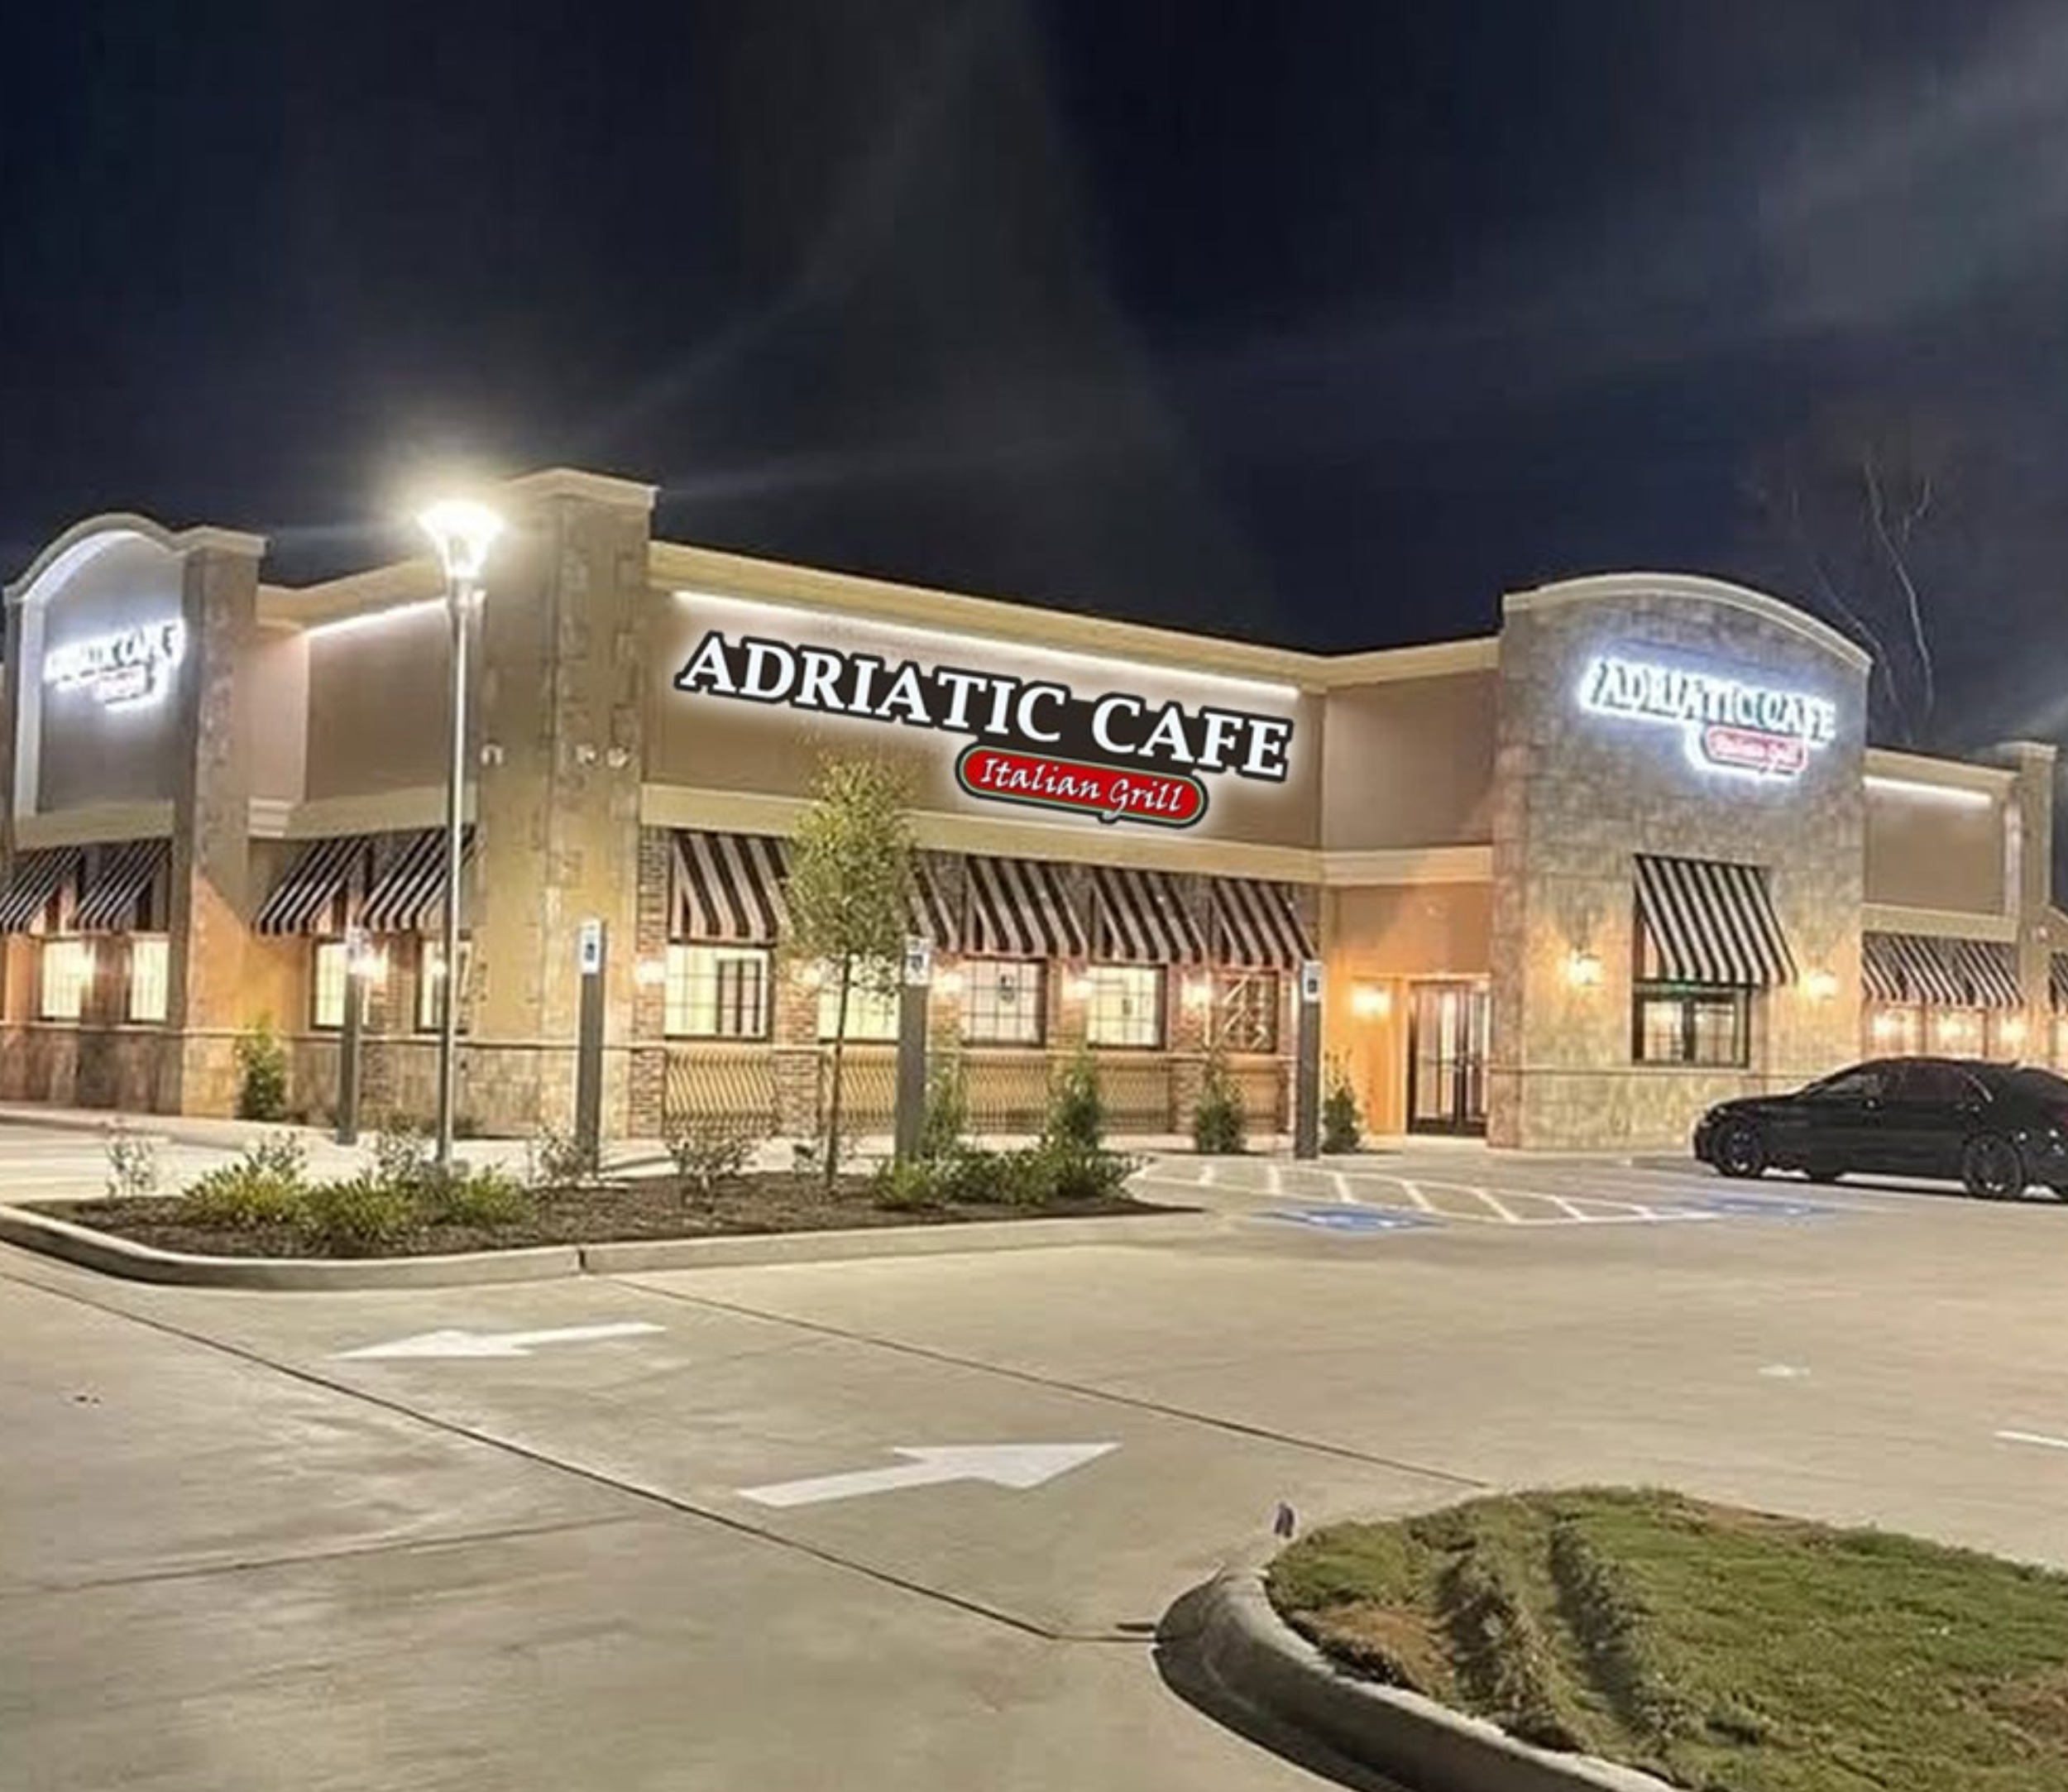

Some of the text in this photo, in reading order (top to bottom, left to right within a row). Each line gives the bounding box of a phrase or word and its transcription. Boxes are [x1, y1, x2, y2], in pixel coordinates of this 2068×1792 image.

[680, 636, 1290, 777] ADRIATIC CAFE
[980, 758, 1183, 820] Italian Grill
